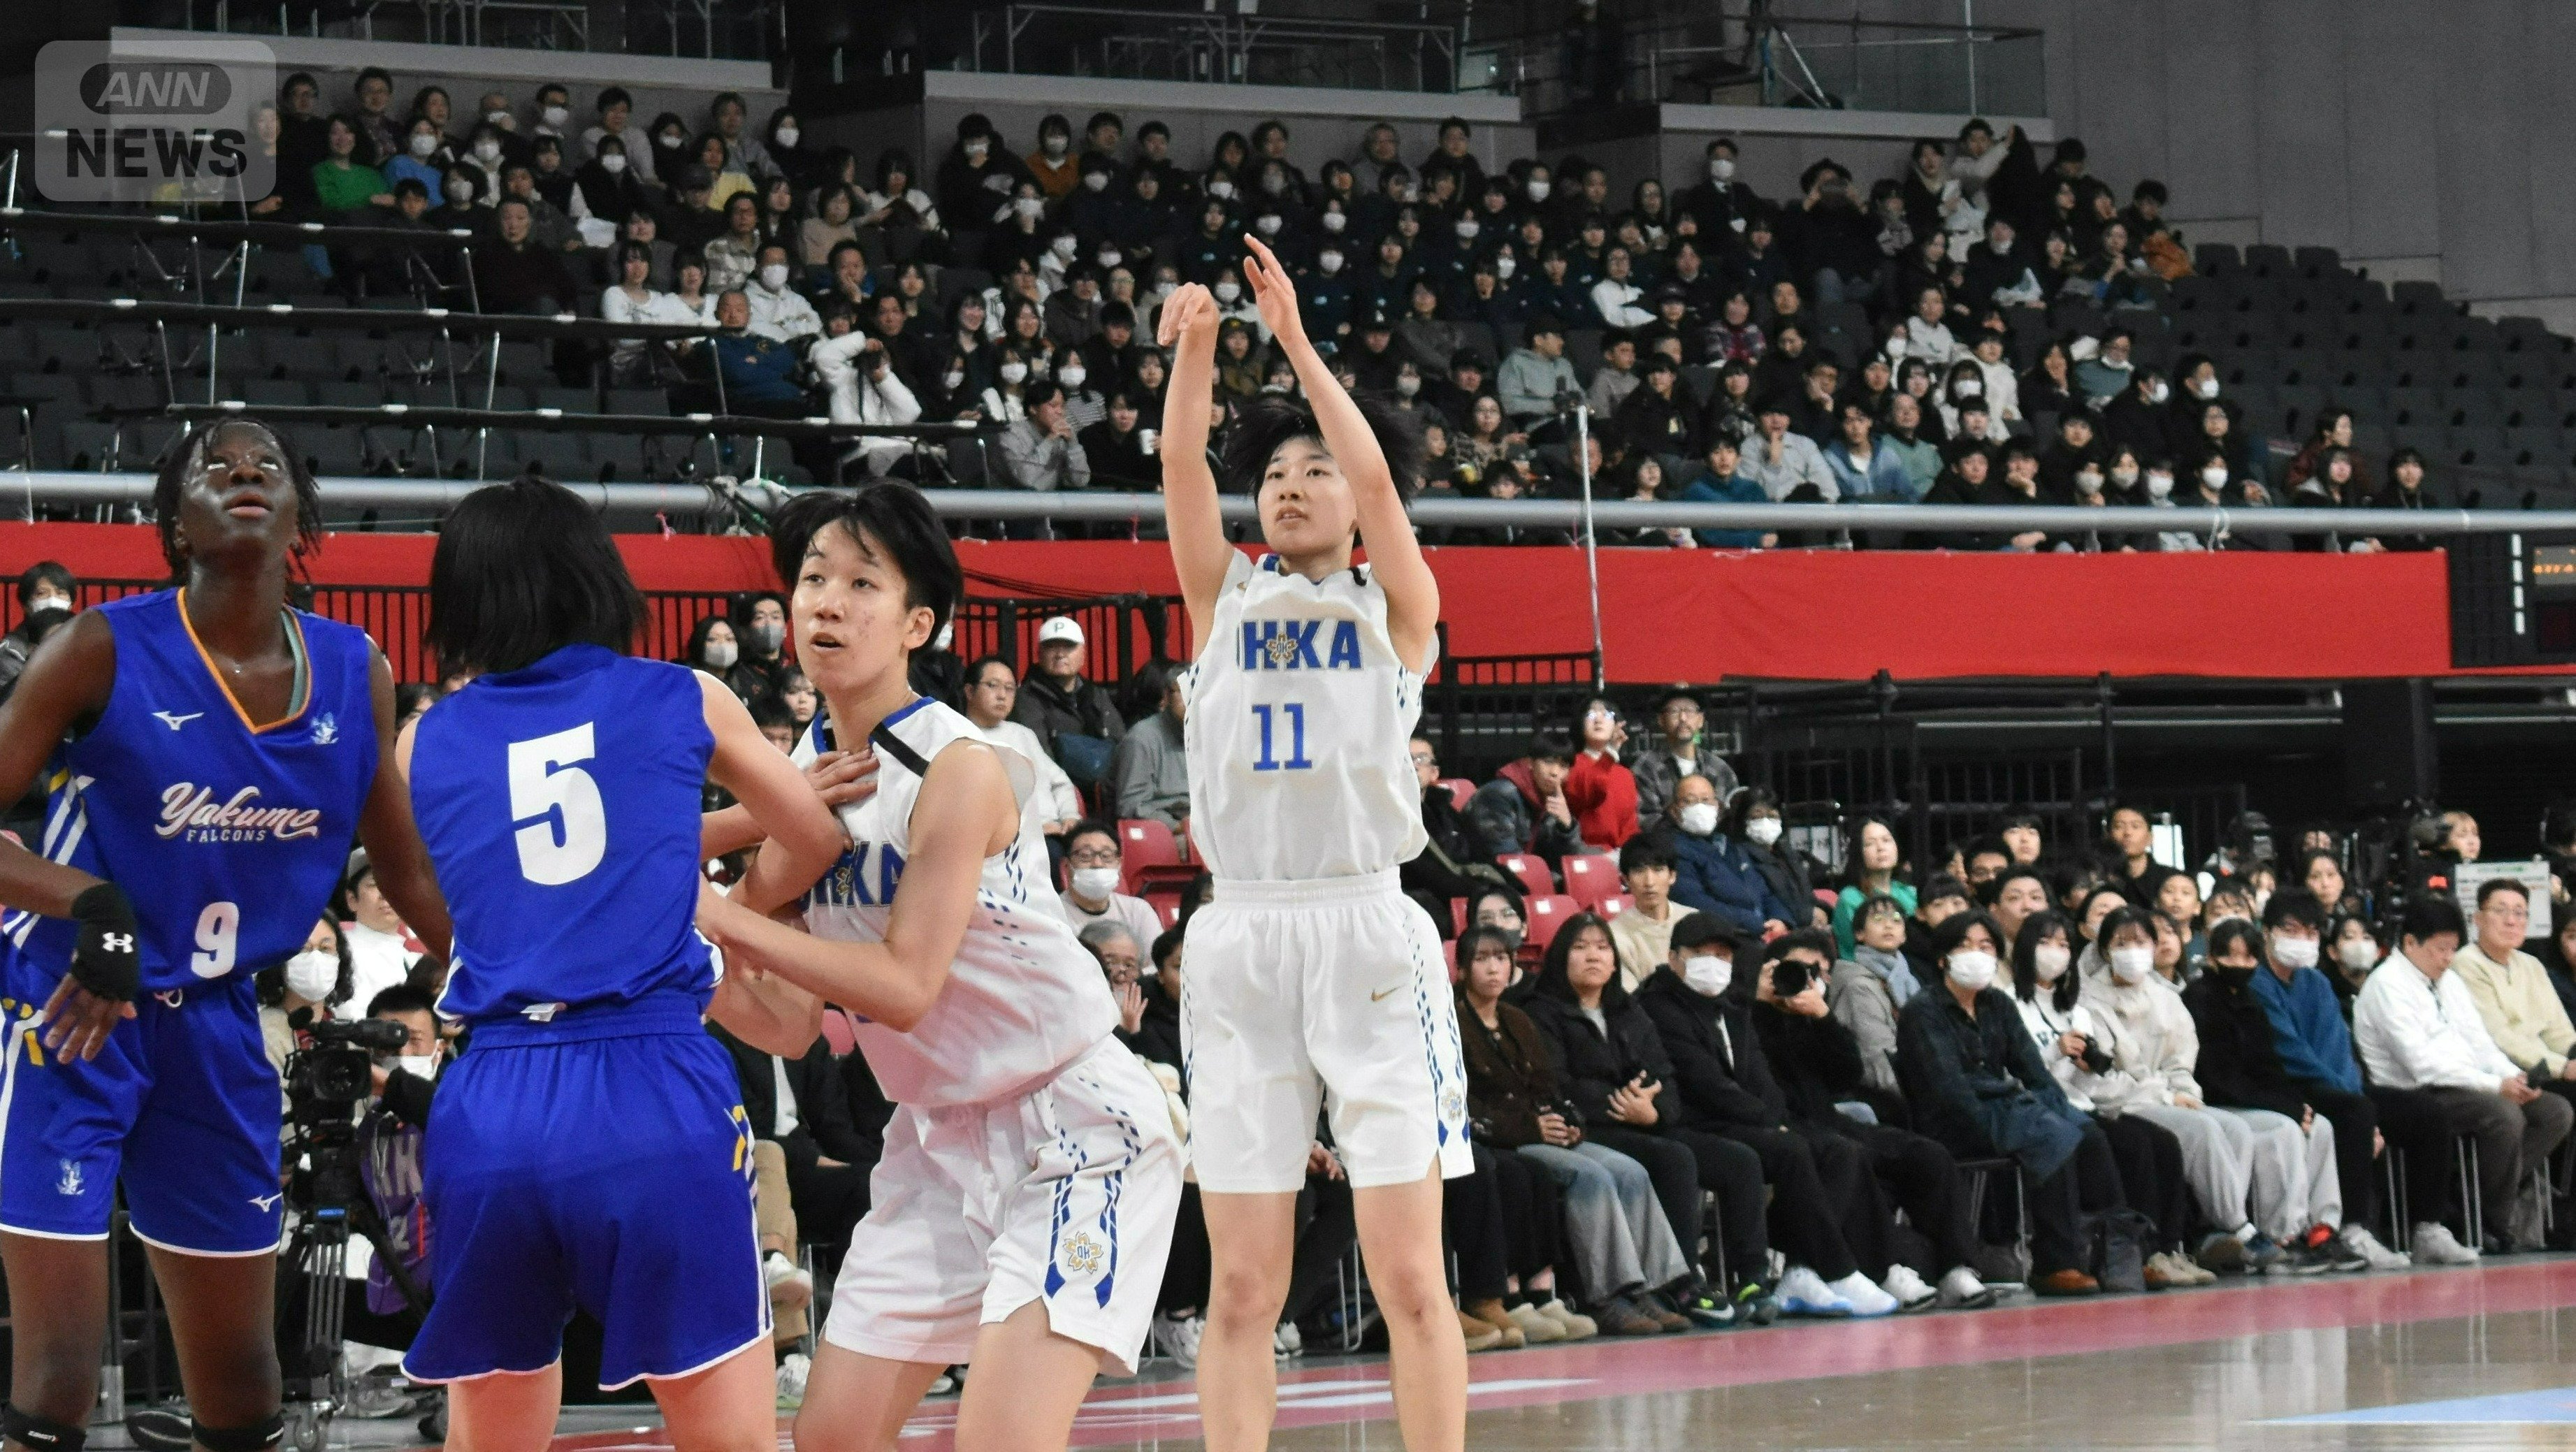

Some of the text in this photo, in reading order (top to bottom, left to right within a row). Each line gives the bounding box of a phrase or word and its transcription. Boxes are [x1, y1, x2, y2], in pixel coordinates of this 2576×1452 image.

[1054, 622, 1065, 633] P
[1236, 618, 1363, 671] HKA
[1252, 702, 1312, 771] 11
[154, 782, 320, 839] Yakumo
[508, 721, 607, 886] 5
[186, 829, 268, 843] FALCONS
[191, 901, 240, 979] 9
